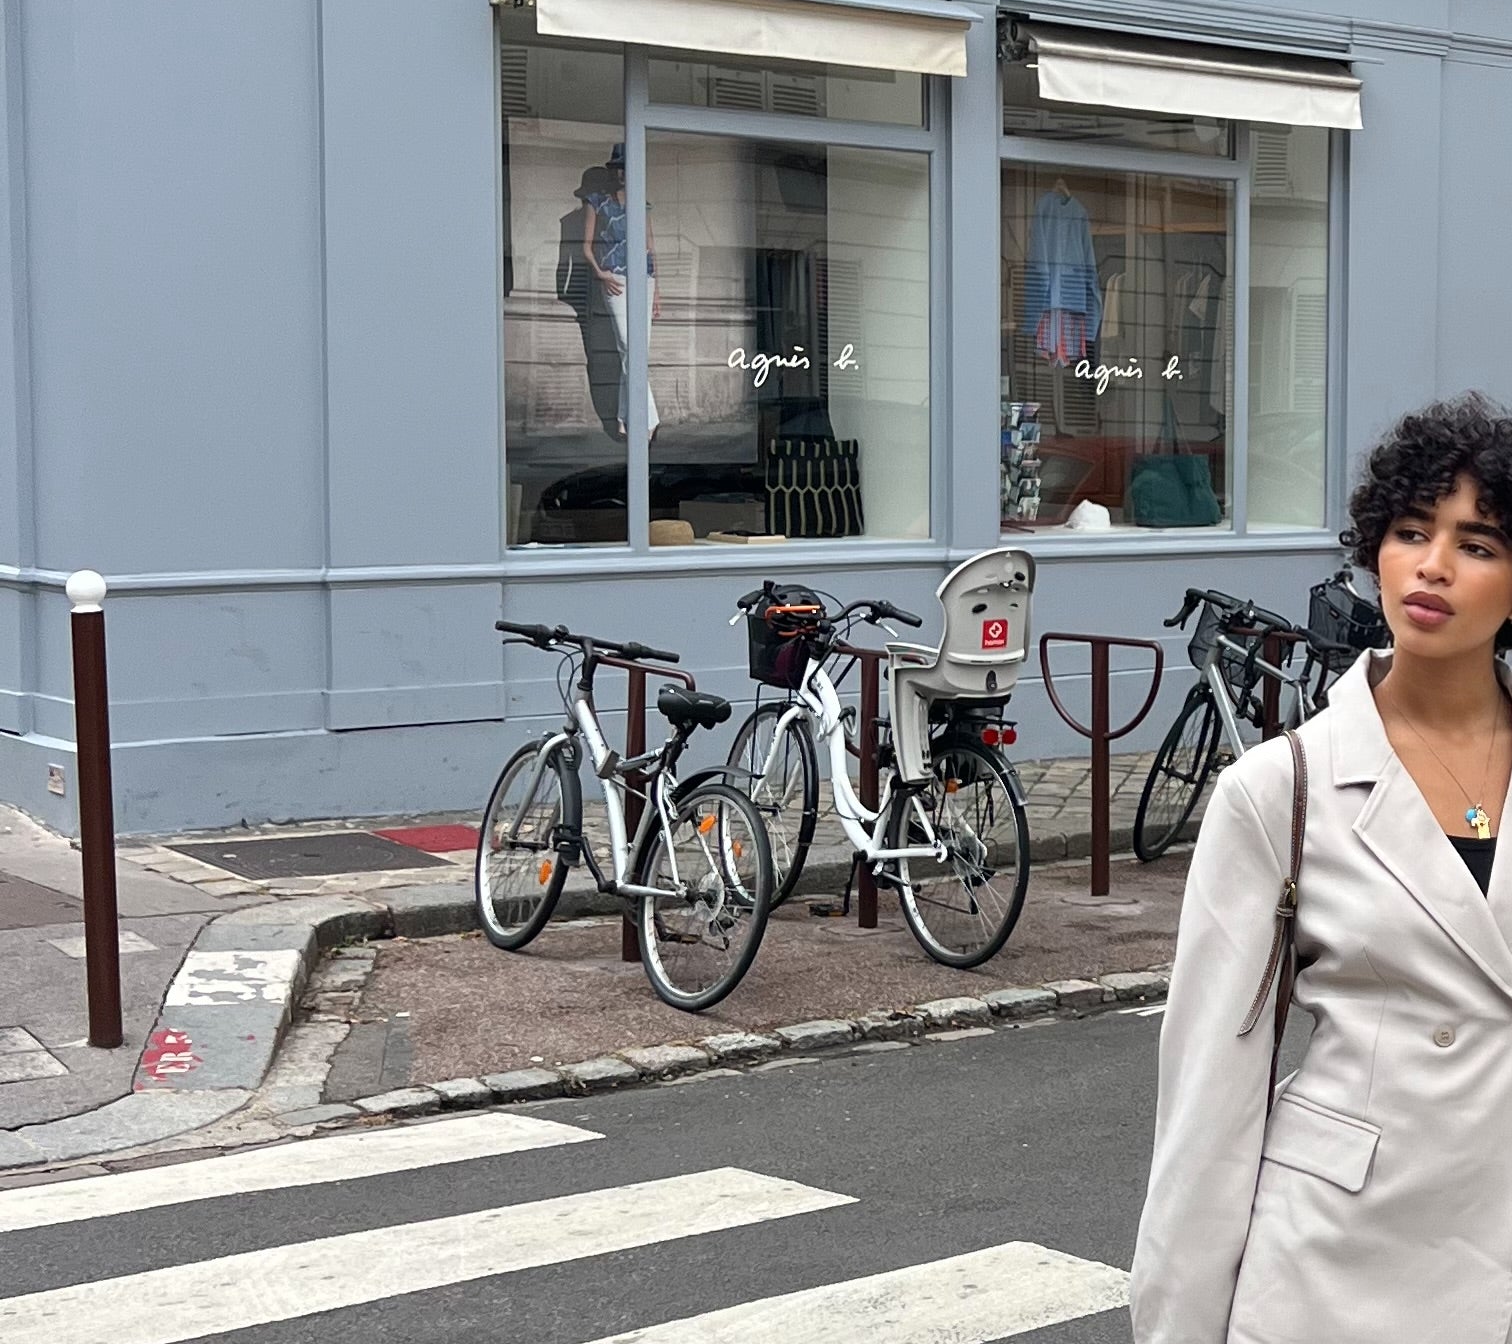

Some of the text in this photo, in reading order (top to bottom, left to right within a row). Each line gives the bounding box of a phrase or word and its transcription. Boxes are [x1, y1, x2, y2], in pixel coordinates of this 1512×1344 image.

[727, 344, 860, 388] agnès b.
[1075, 355, 1184, 395] agnès b.
